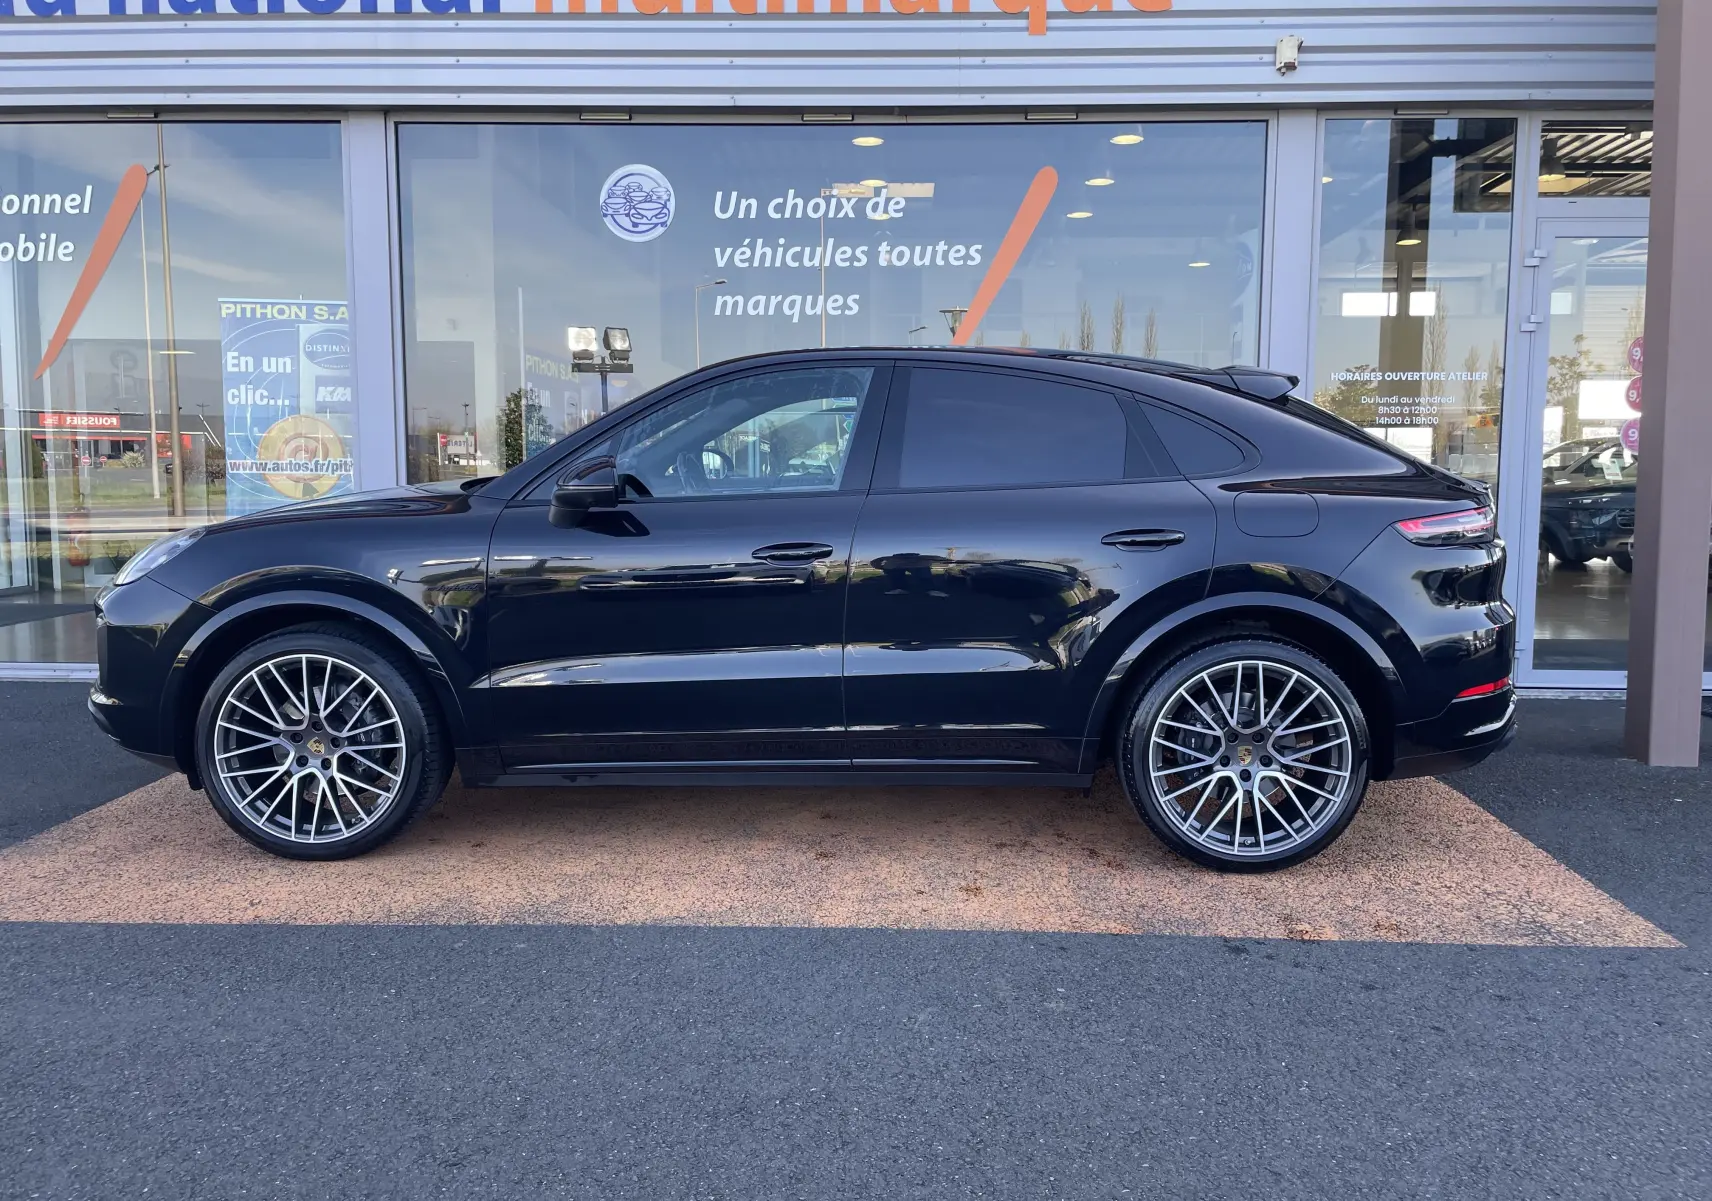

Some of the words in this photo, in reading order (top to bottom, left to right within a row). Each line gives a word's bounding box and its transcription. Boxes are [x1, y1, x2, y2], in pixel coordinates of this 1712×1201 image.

[714, 191, 758, 219] Un
[767, 189, 858, 219] choix
[865, 188, 906, 219] de
[0, 232, 75, 262] obile
[714, 237, 868, 268] véhicules
[878, 240, 982, 267] toutes
[220, 303, 307, 320] PITHON
[714, 293, 860, 322] marques
[226, 351, 254, 373] En
[262, 357, 292, 373] un
[1331, 372, 1382, 381] HORAIRES
[1385, 372, 1446, 381] OUVERTURE
[1448, 372, 1488, 381] ATELIER
[227, 384, 290, 406] clic...
[1361, 396, 1374, 404] Du
[1375, 395, 1398, 404] lundi
[1414, 395, 1455, 404] vendredi
[1375, 416, 1401, 425] 14h00
[1403, 416, 1411, 425] à
[1412, 416, 1439, 425] 18h00
[1378, 406, 1401, 414] 8h30
[1403, 406, 1410, 414] à
[1412, 406, 1437, 414] 12h00
